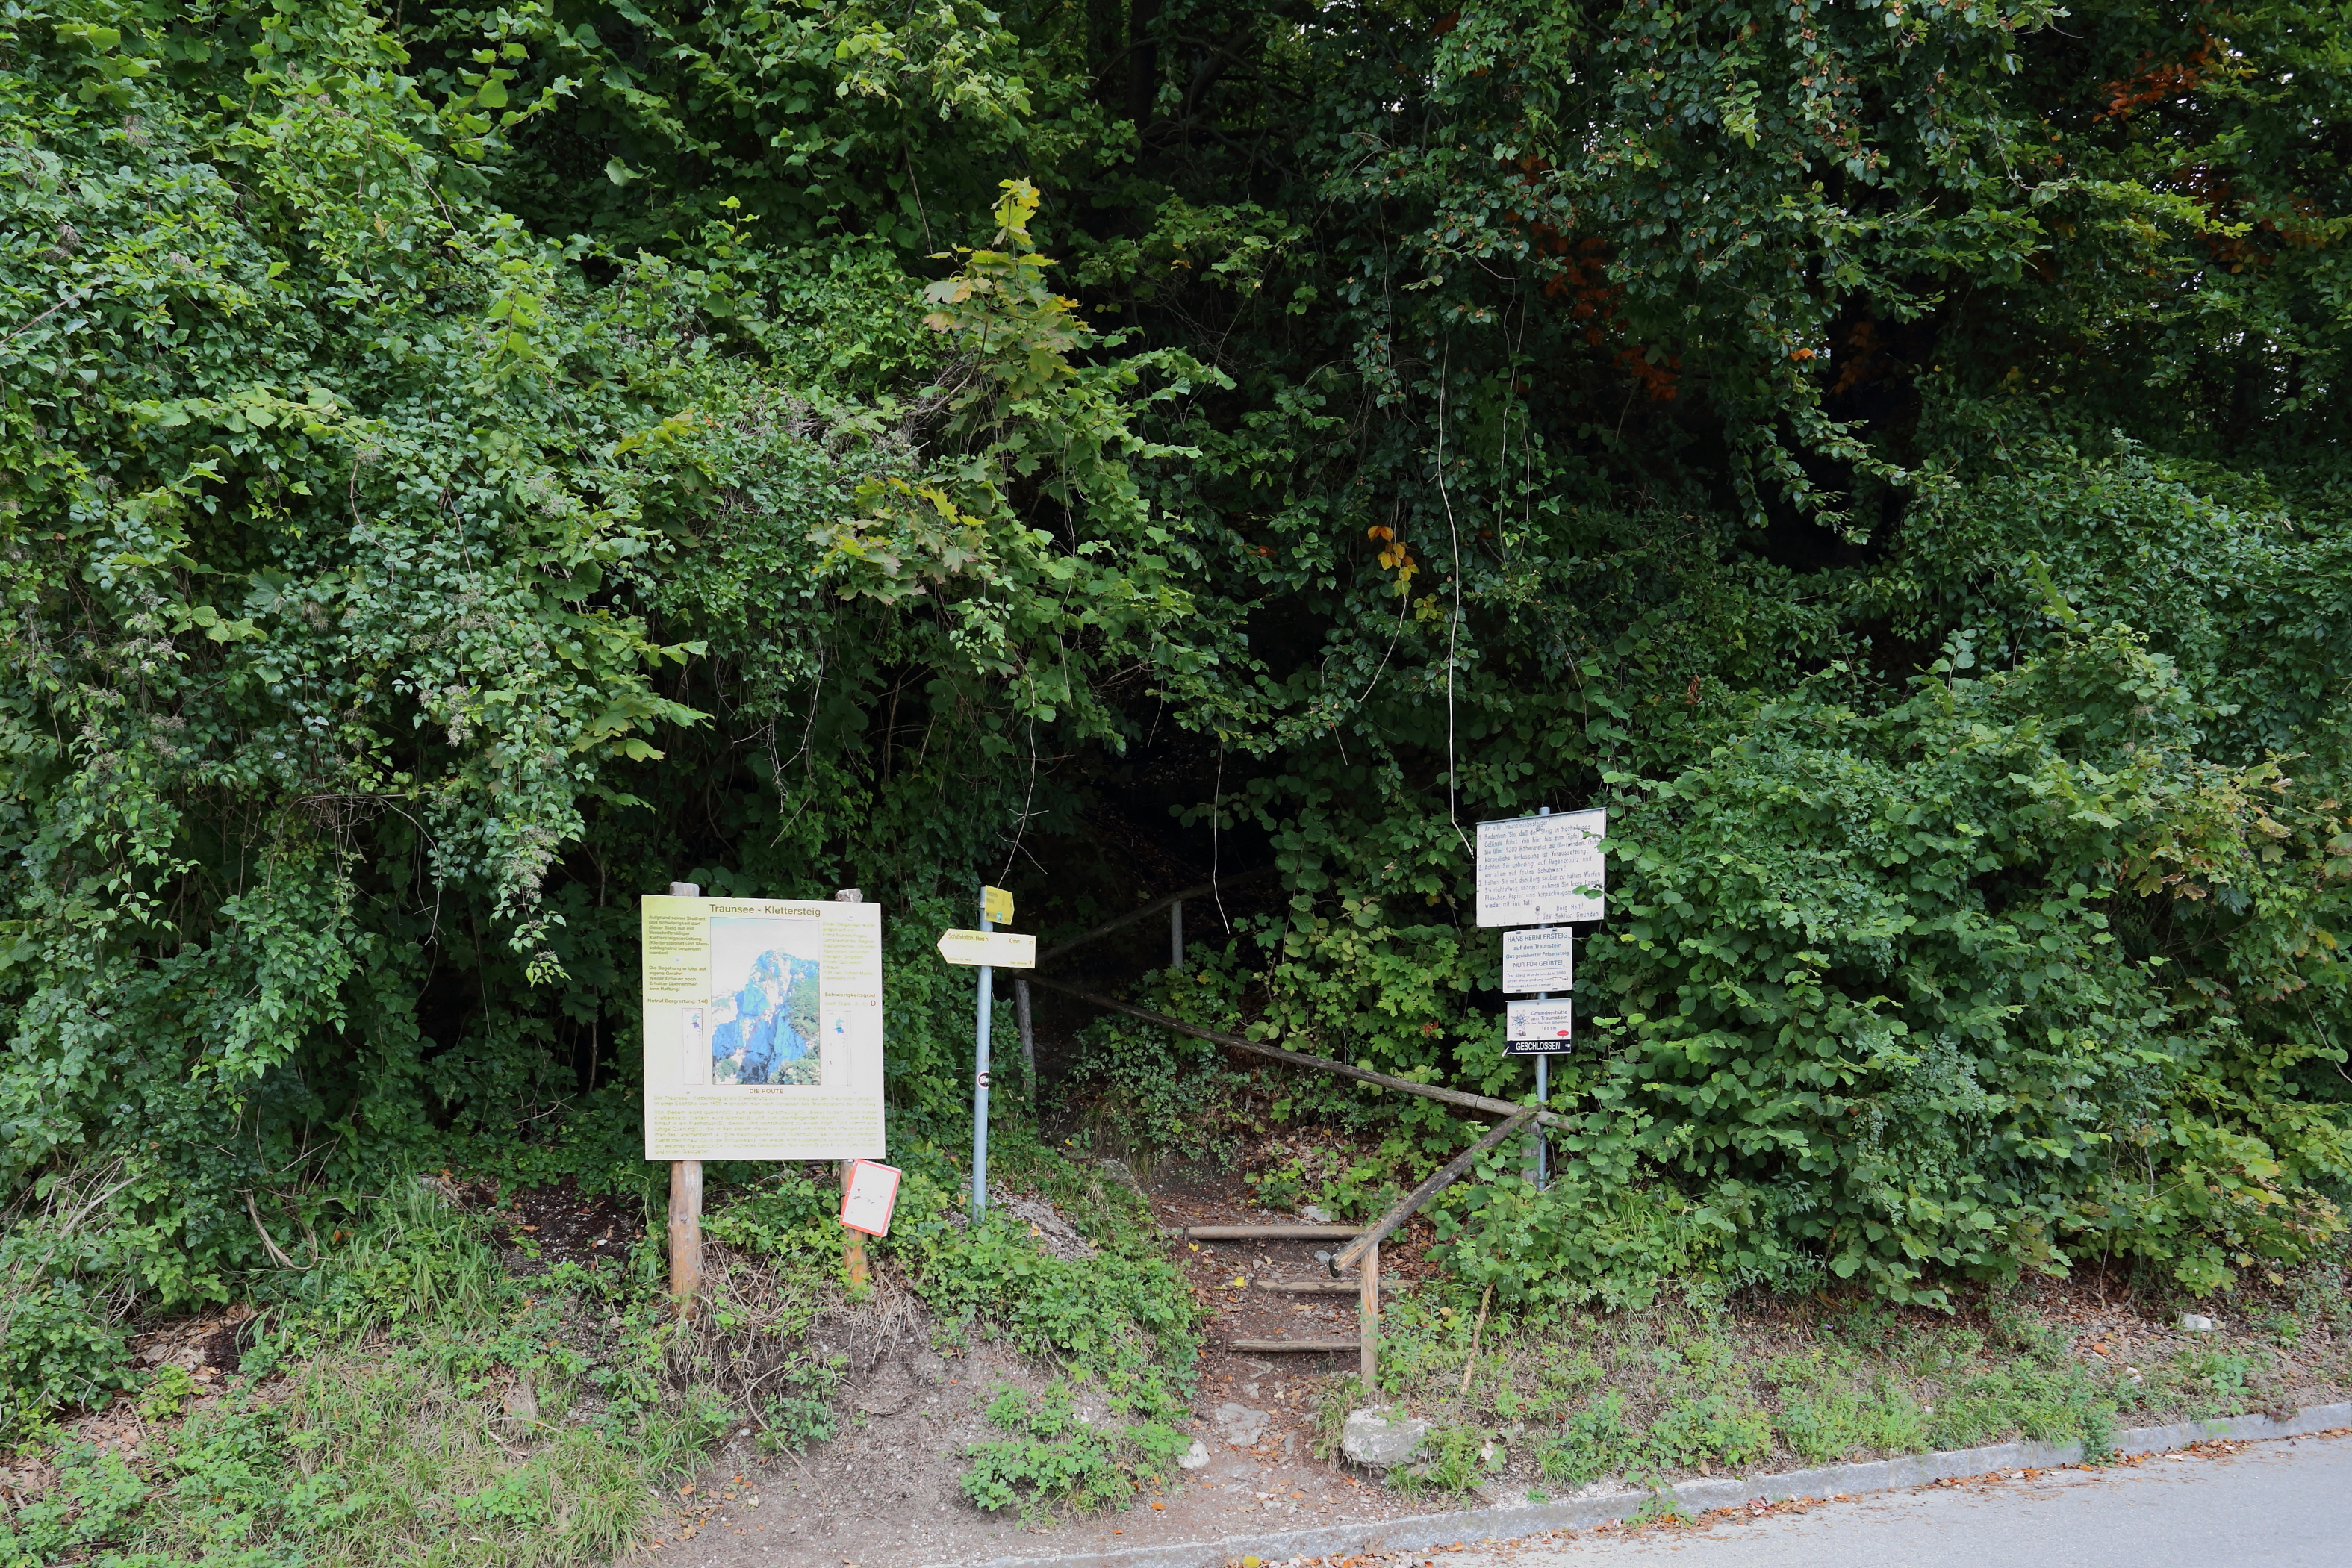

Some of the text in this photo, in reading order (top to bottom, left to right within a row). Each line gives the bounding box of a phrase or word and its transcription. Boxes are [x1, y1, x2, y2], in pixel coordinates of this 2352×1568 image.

[1504, 819, 1551, 830] Traunsteinbesteiger!
[1540, 827, 1552, 835] Steig
[1566, 833, 1579, 841] Gipfel
[1549, 857, 1579, 866] Regenschutz
[1537, 865, 1566, 874] Schuhwerk!
[709, 903, 755, 913] Traunsee
[764, 906, 821, 918] Klettersteig
[1556, 904, 1568, 912] Berg
[1524, 932, 1568, 941] HERNLERSTEIG
[1515, 951, 1542, 960] gesicherter
[1542, 950, 1569, 958] Felsensteig
[1526, 959, 1537, 968] FÜR
[1538, 959, 1563, 967] GEÜBTE!
[1516, 1042, 1561, 1051] GESCHLOSSEN
